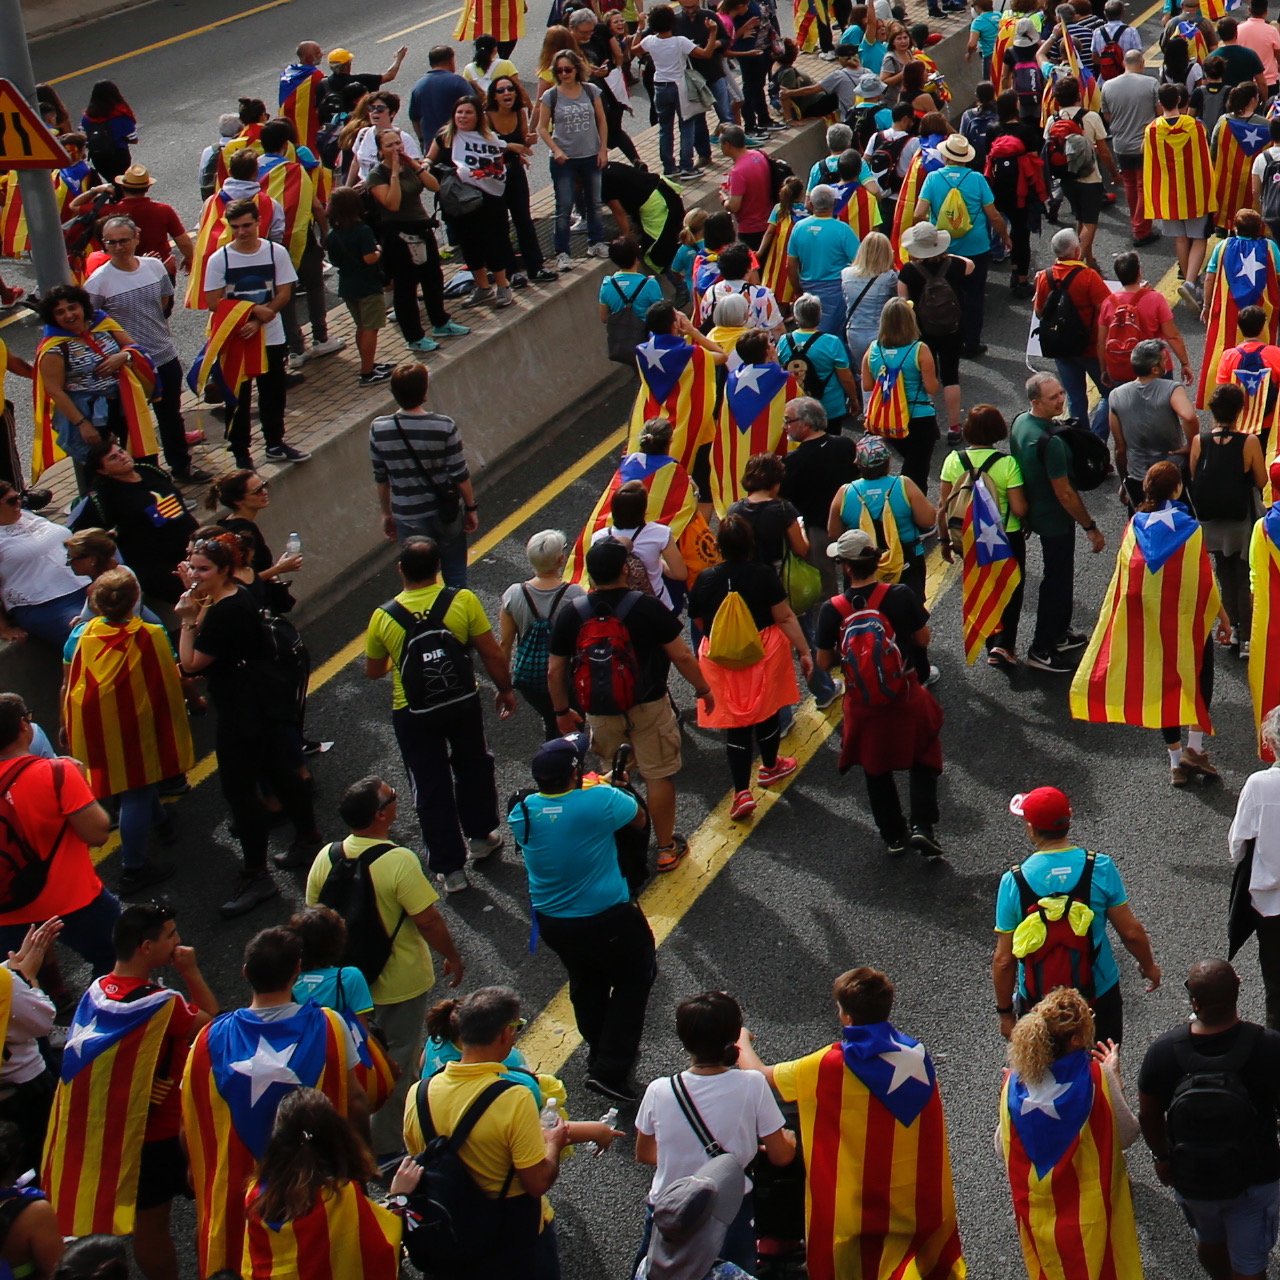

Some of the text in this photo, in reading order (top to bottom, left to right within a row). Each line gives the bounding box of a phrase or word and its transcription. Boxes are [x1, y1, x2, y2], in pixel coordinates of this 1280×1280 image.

[563, 103, 589, 115] FAN
[564, 111, 590, 124] TAS
[564, 121, 590, 134] TIC
